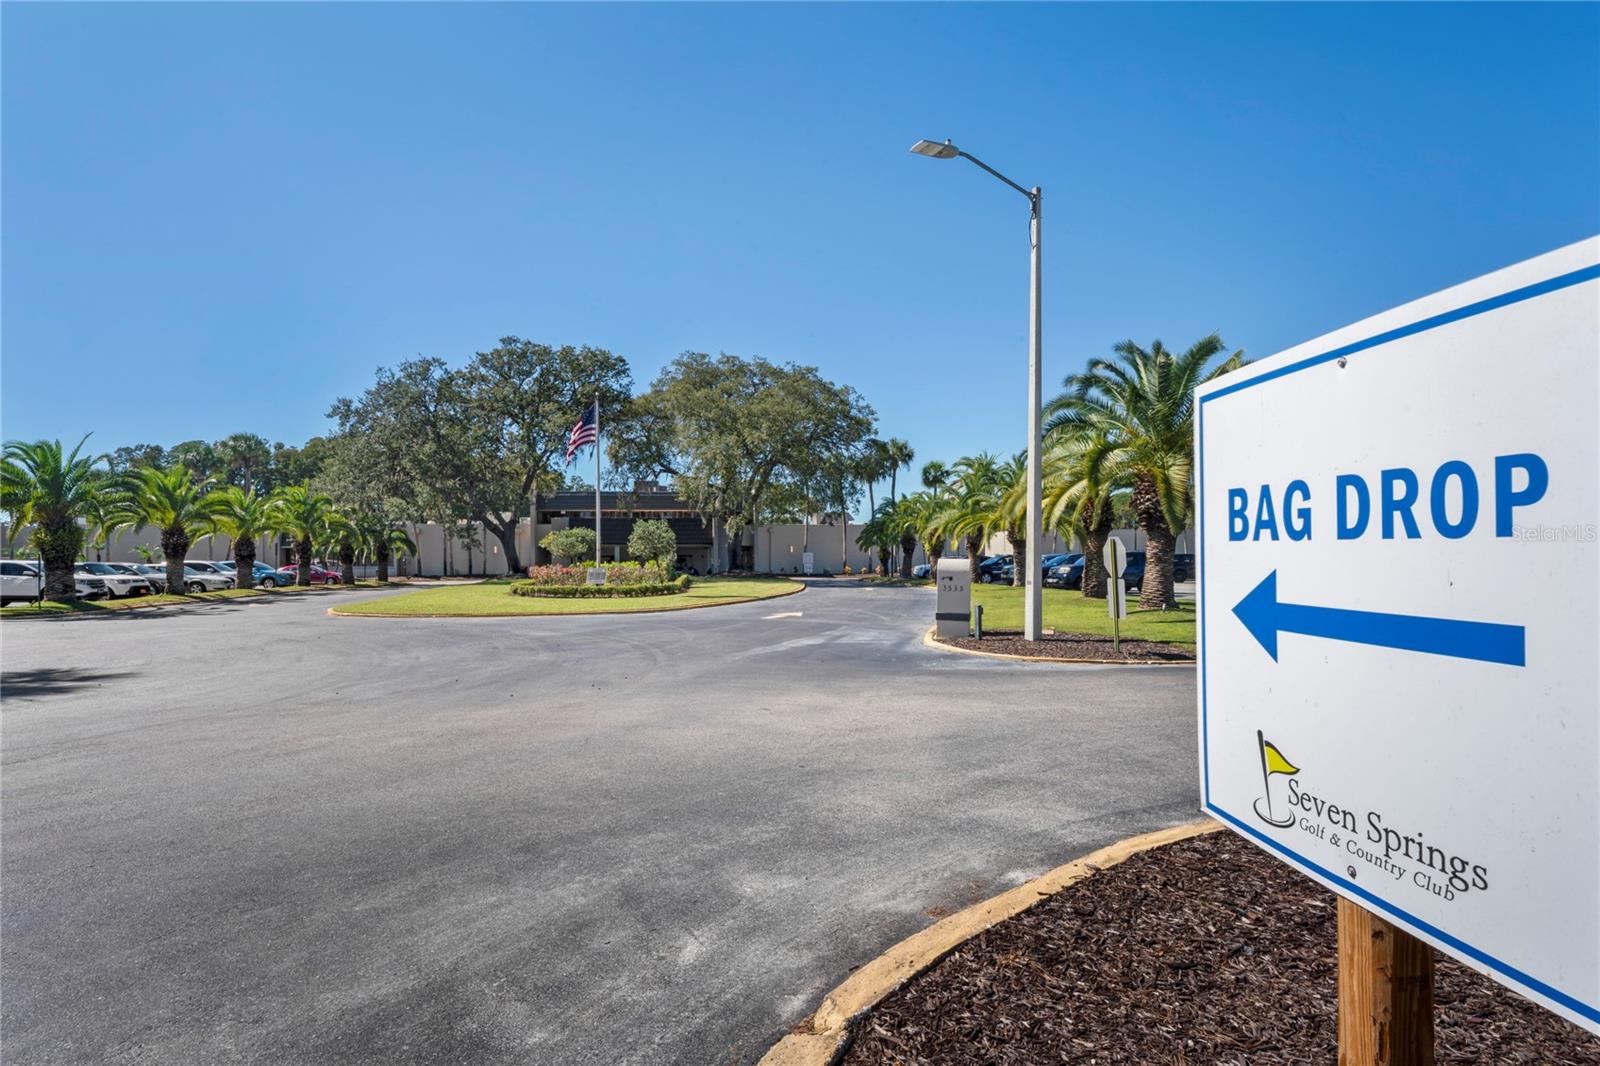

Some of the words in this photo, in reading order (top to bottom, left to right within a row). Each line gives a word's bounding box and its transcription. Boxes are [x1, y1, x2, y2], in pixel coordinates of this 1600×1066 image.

[1228, 480, 1312, 542] BAG
[1336, 453, 1549, 540] DROP
[1288, 778, 1358, 835] Seven
[1367, 811, 1489, 893] Springs
[1299, 817, 1325, 840] Golf
[1329, 833, 1341, 848] &
[1346, 839, 1407, 881] Country
[1413, 871, 1456, 902] Club
